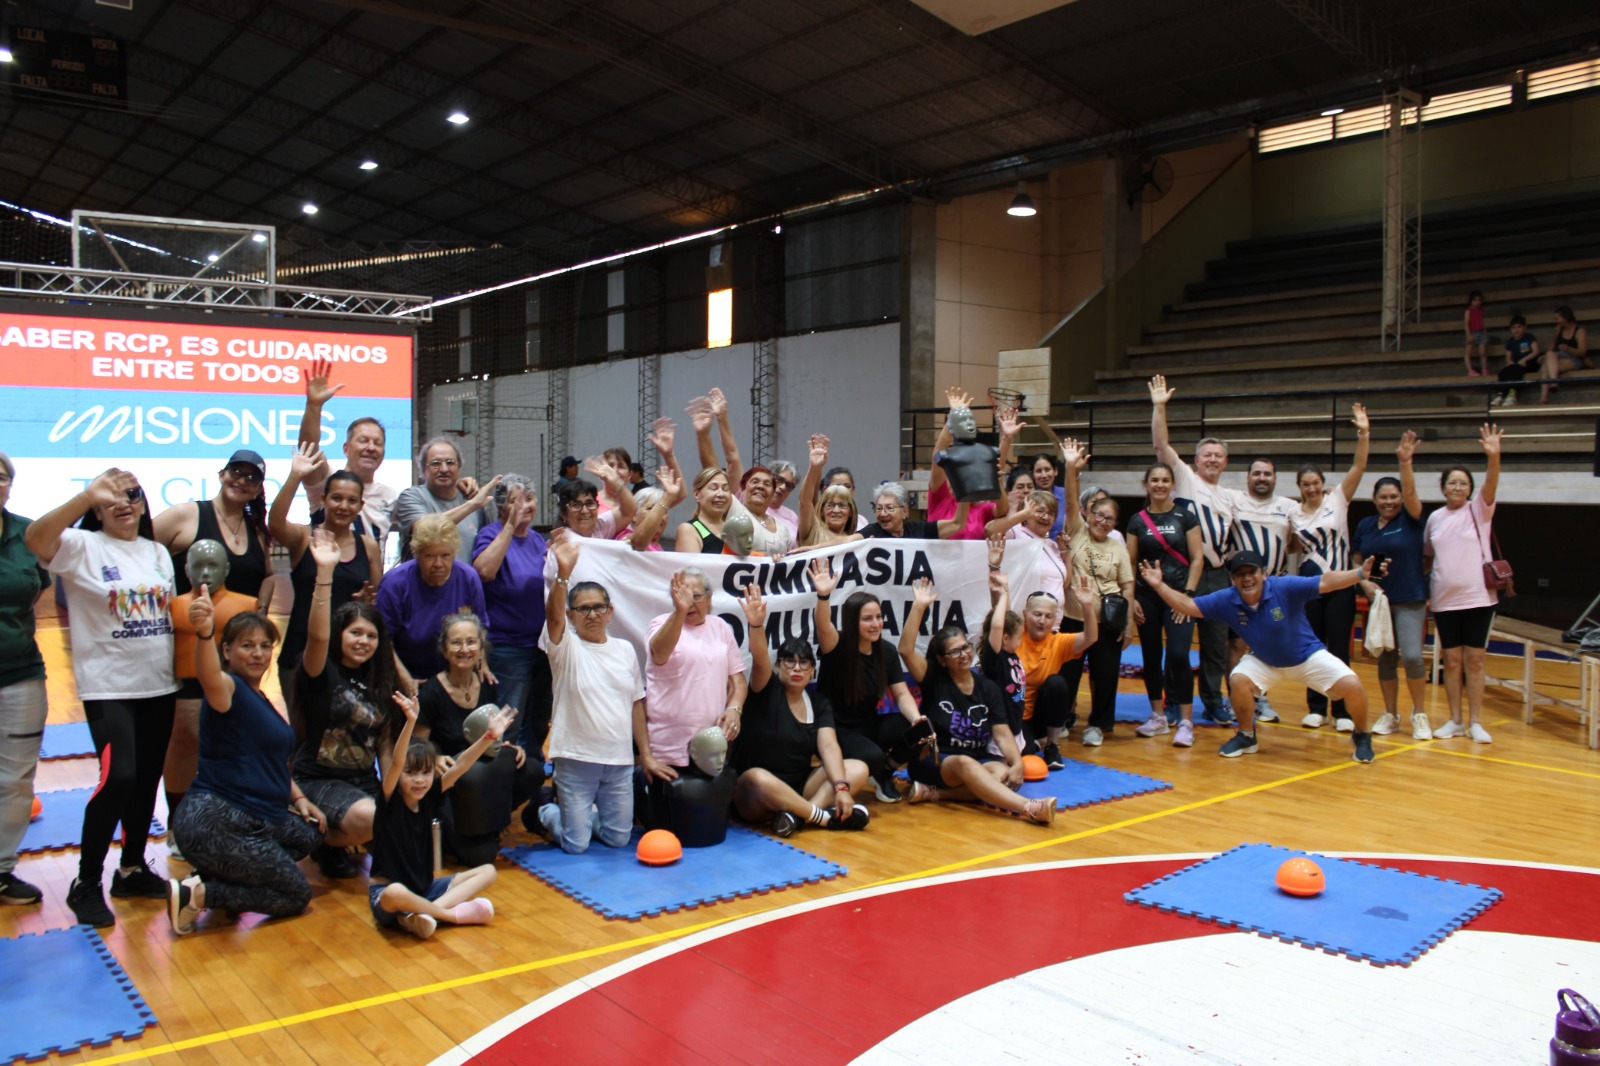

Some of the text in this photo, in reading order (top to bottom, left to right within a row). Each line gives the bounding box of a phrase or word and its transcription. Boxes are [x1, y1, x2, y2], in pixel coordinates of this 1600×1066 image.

[17, 27, 48, 43] LOCAL
[20, 73, 48, 88] FALTA
[92, 83, 118, 96] FALTA
[0, 326, 388, 364] ABER RCP, ES CUIDARNOS
[92, 357, 300, 384] ENTRE TODOS
[48, 405, 337, 447] MISIONES
